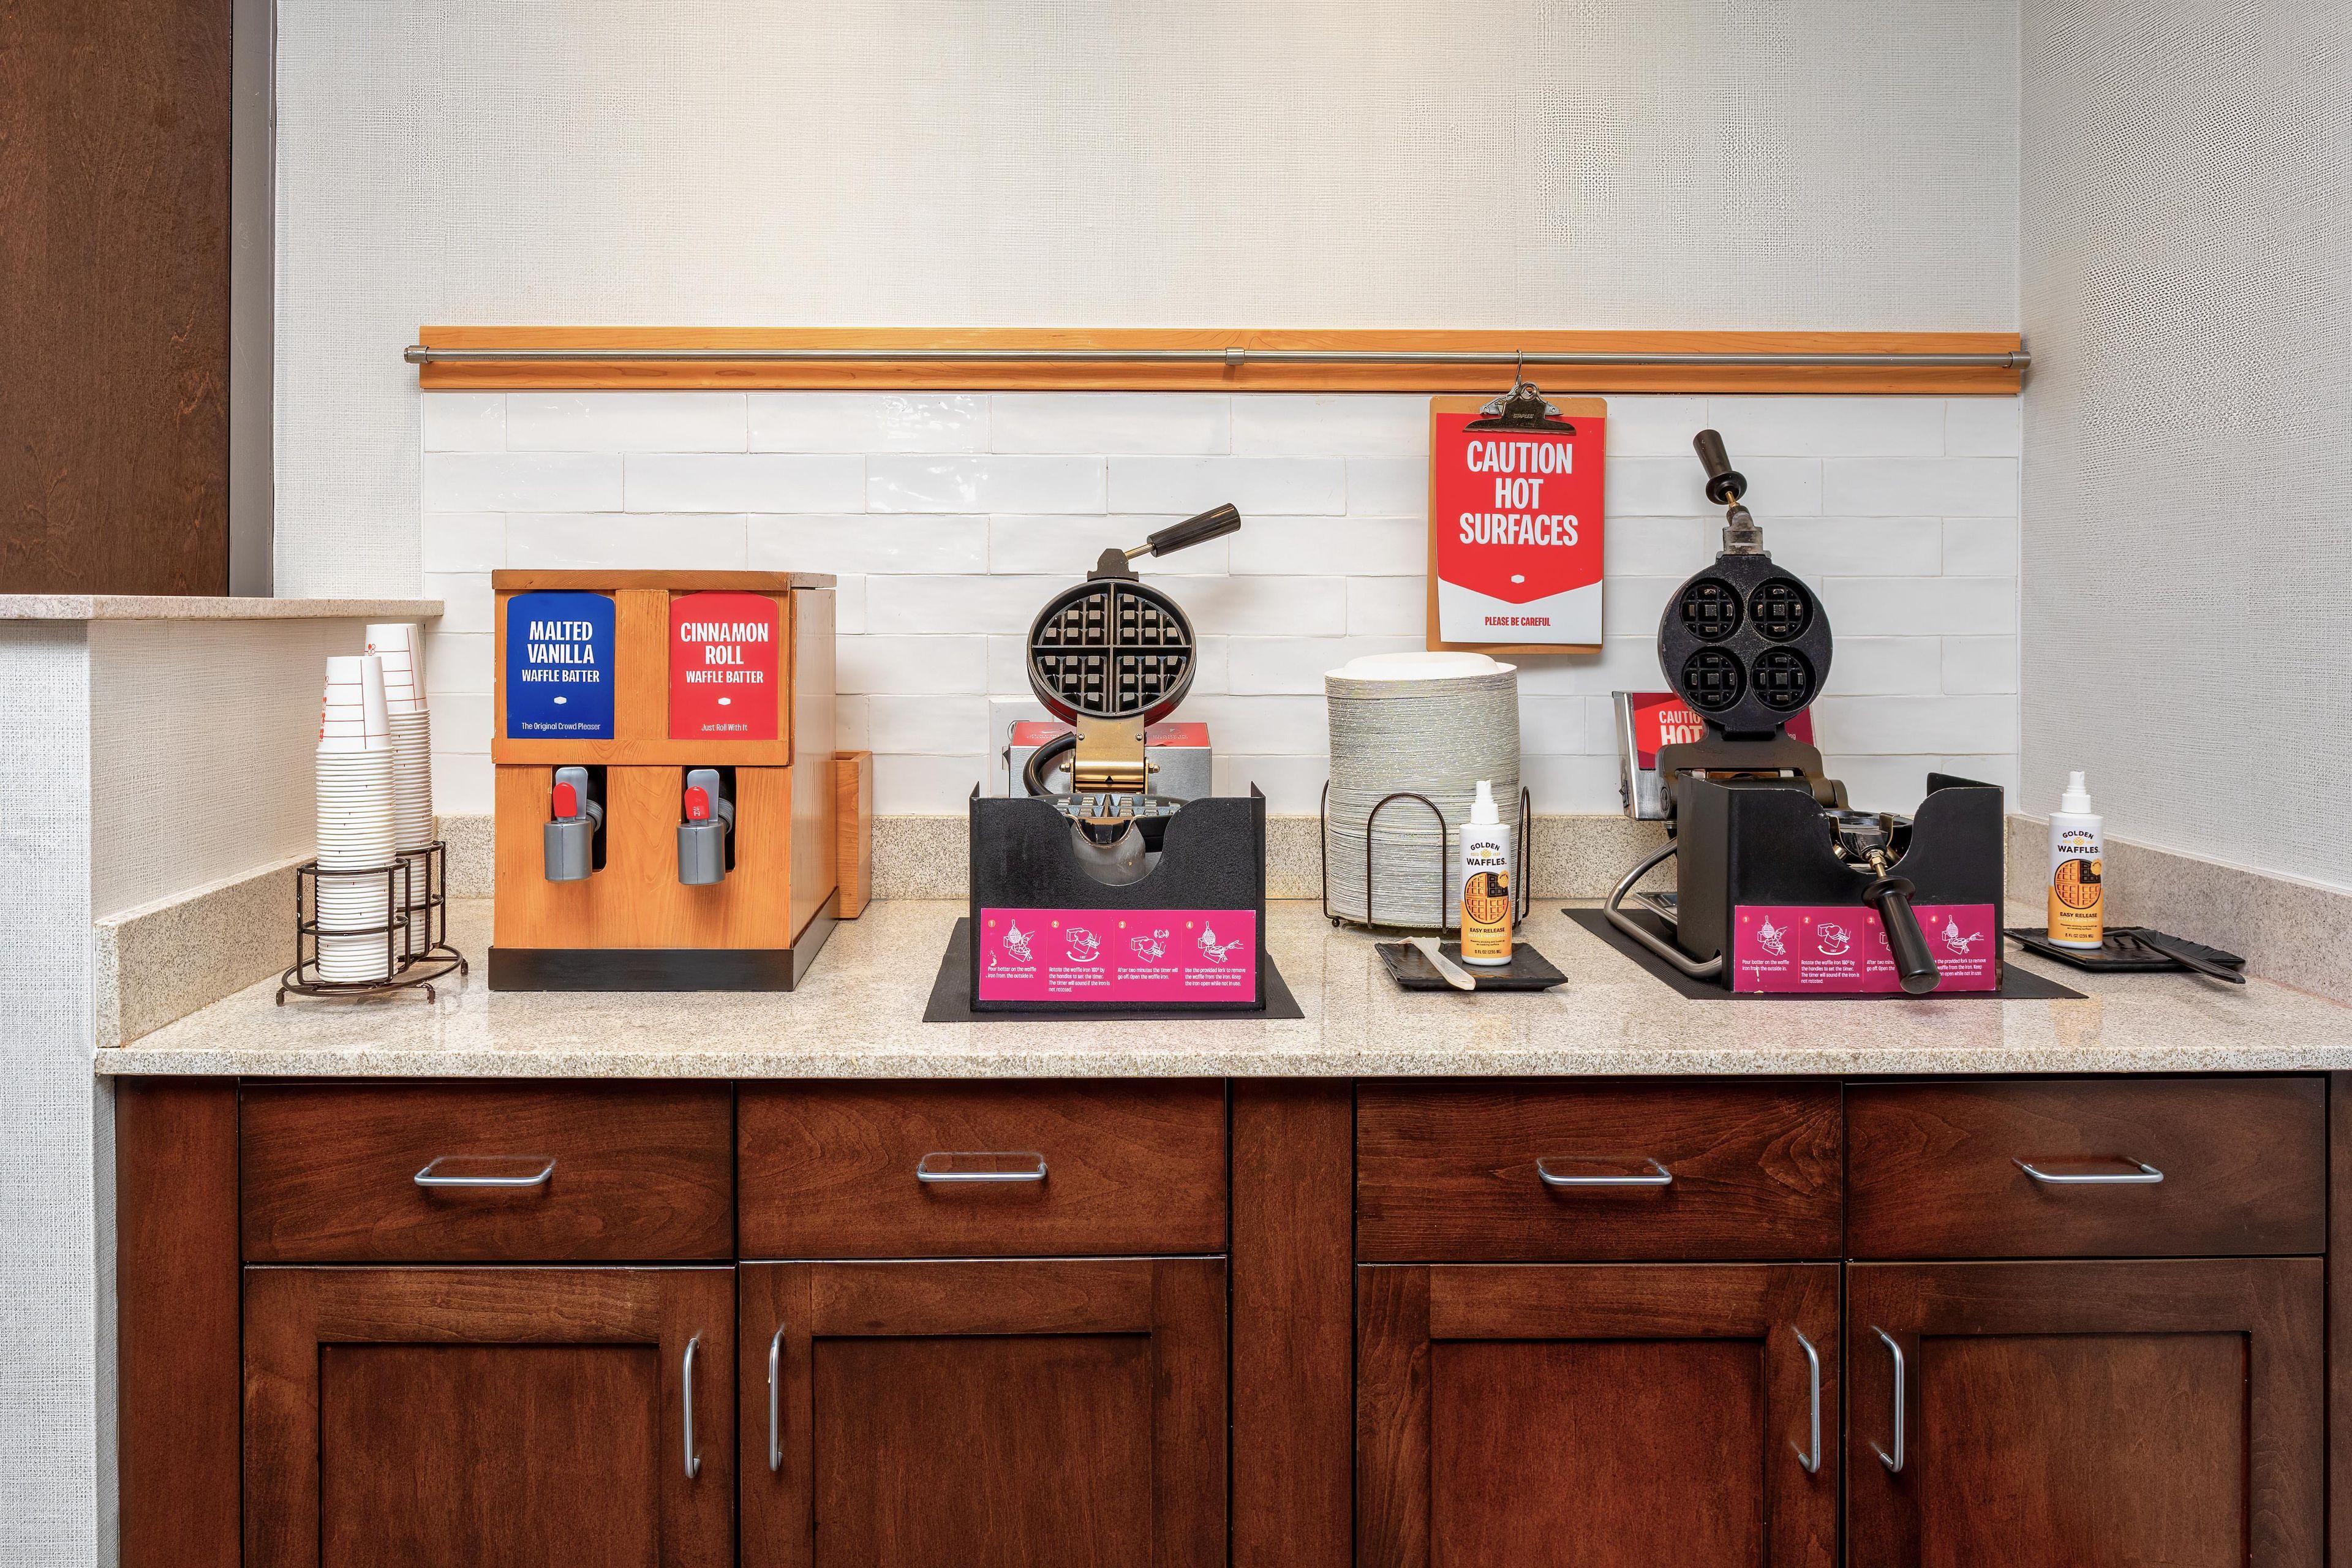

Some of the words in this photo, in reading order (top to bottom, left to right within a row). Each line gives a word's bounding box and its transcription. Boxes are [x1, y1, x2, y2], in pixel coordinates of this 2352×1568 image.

[1468, 441, 1572, 473] CAUTION
[1496, 478, 1544, 509] HOT
[1460, 513, 1578, 546] SURFACES
[530, 621, 592, 641] MALTED
[1485, 617, 1509, 625] PLEASE
[1511, 617, 1519, 626] BE
[1521, 617, 1550, 626] CAREFUL
[681, 623, 768, 642] CINNAMON
[527, 644, 594, 663] VANILLA
[706, 646, 744, 665] ROLL
[522, 669, 559, 682] WAFFLE
[562, 670, 599, 682] BATTER
[686, 671, 723, 682] WAFFLE
[726, 671, 763, 683] BATTER
[1659, 710, 1701, 723] CAUTIO
[1660, 725, 1703, 745] HOT
